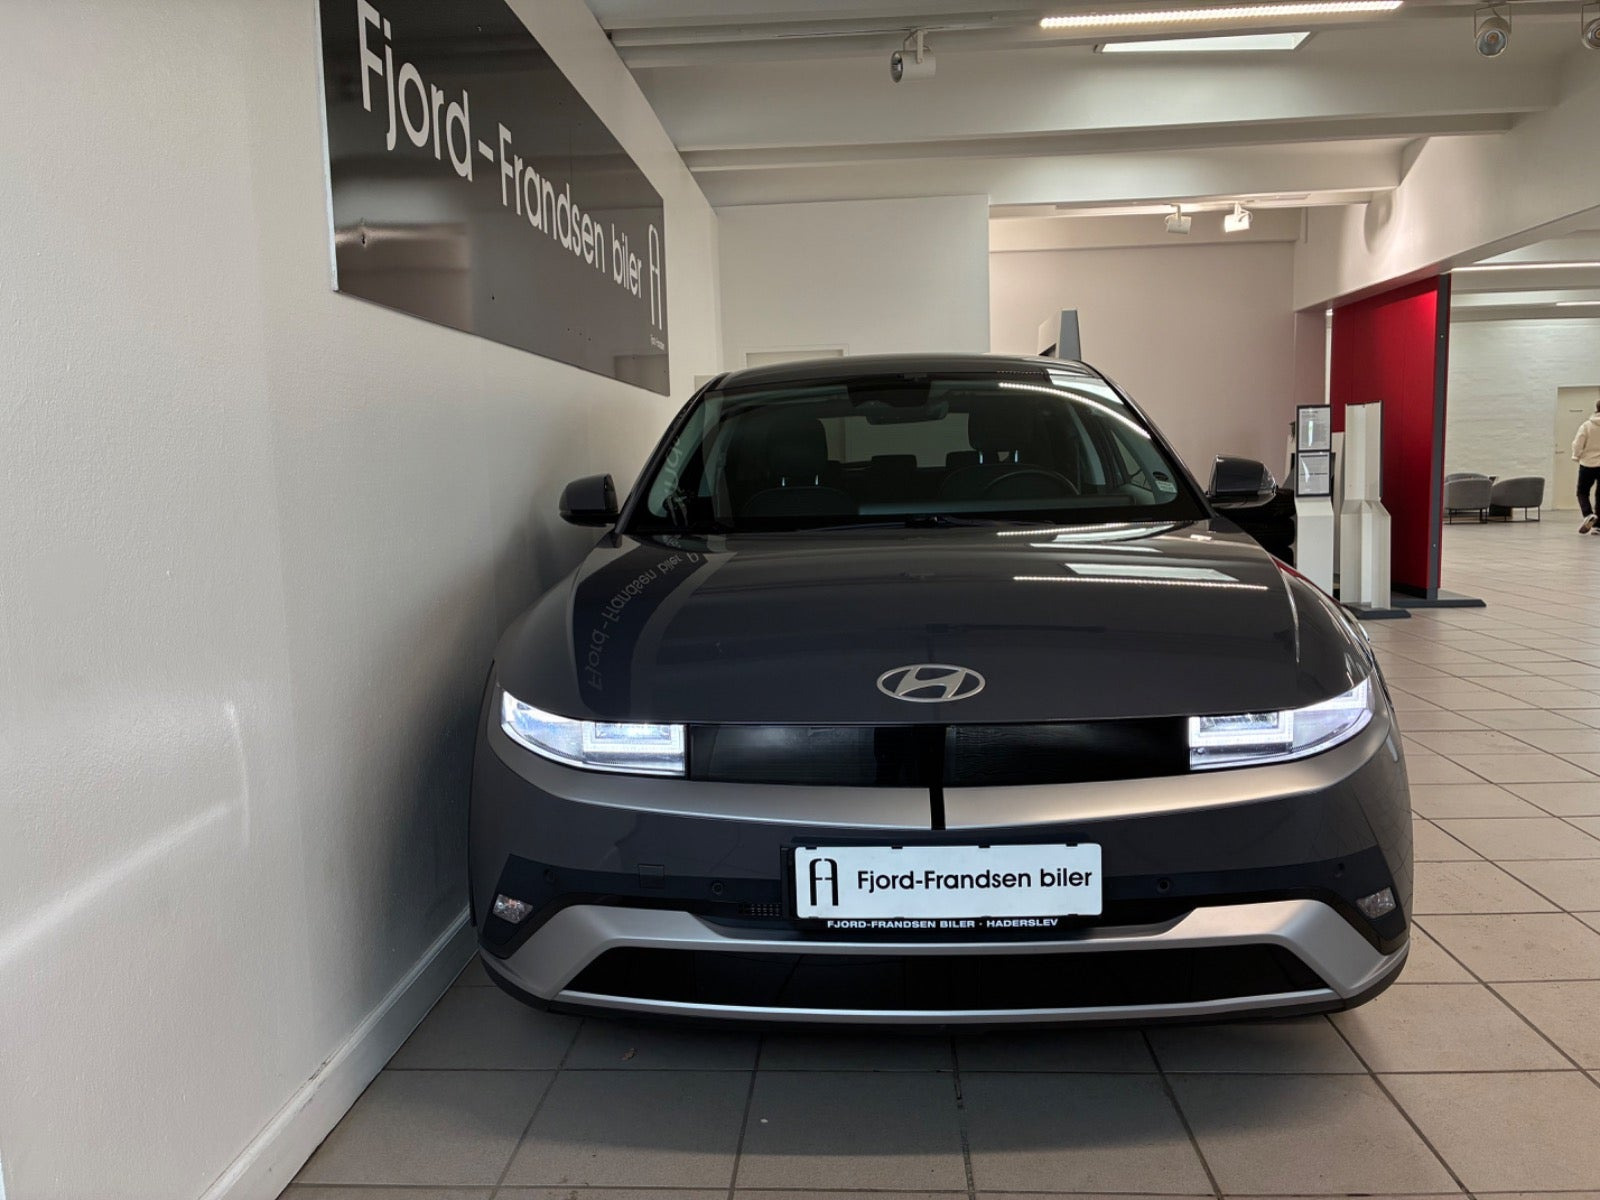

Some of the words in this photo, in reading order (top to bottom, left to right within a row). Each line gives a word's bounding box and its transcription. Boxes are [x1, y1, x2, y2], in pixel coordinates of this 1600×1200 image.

[357, 0, 605, 273] Fjord-Frandsen
[612, 223, 642, 298] biler
[857, 869, 1032, 893] Fjord-Frandsen
[1040, 868, 1092, 888] biler
[827, 919, 936, 929] FJORD-FRANDSEN
[940, 919, 975, 929] BILER
[986, 918, 1058, 928] HADERSLEV
